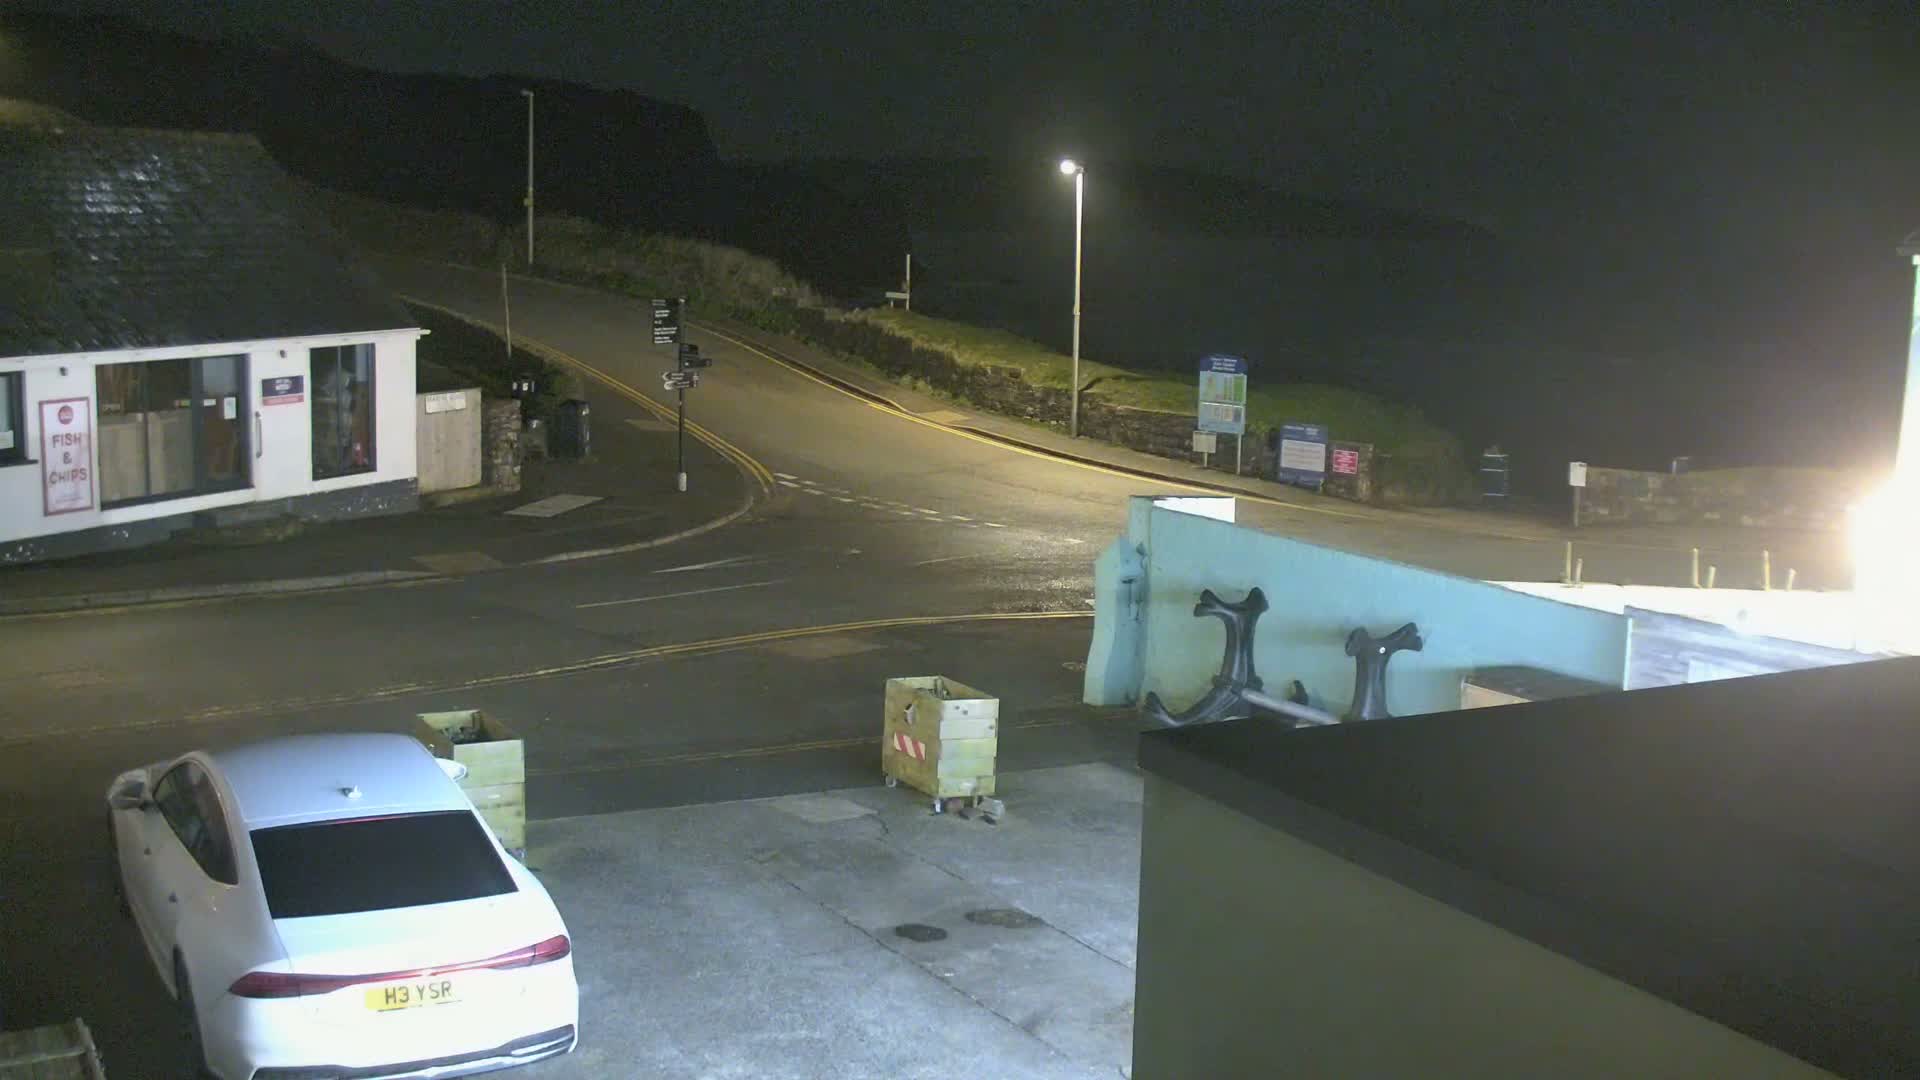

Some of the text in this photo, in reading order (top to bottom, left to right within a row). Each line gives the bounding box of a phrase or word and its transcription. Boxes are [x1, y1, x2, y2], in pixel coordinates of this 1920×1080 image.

[52, 432, 82, 448] FISH
[63, 451, 73, 465] &
[49, 468, 88, 485] CHIPS
[384, 981, 452, 1005] H3 YSR
